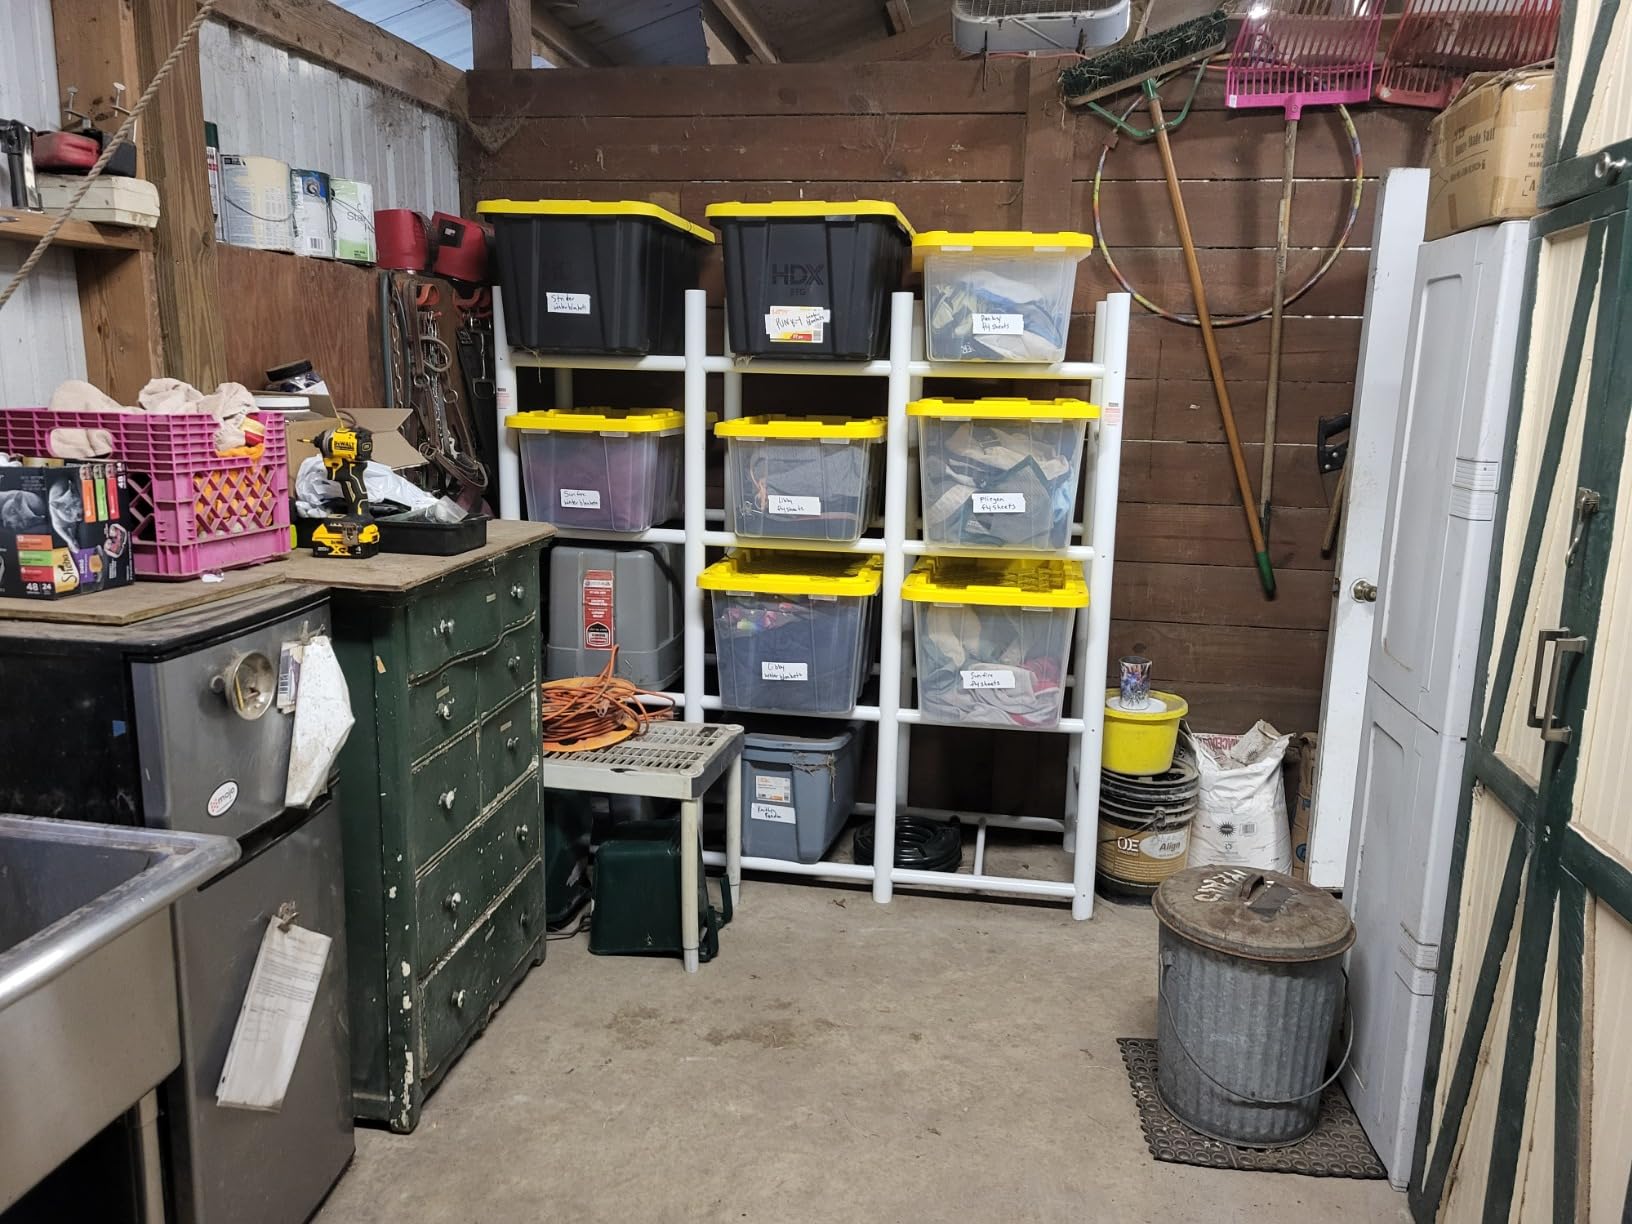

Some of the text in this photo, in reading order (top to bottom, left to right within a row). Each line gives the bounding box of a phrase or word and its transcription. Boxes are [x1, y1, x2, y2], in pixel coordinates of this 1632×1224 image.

[772, 263, 824, 285] HDX
[26, 582, 52, 591] 48 24
